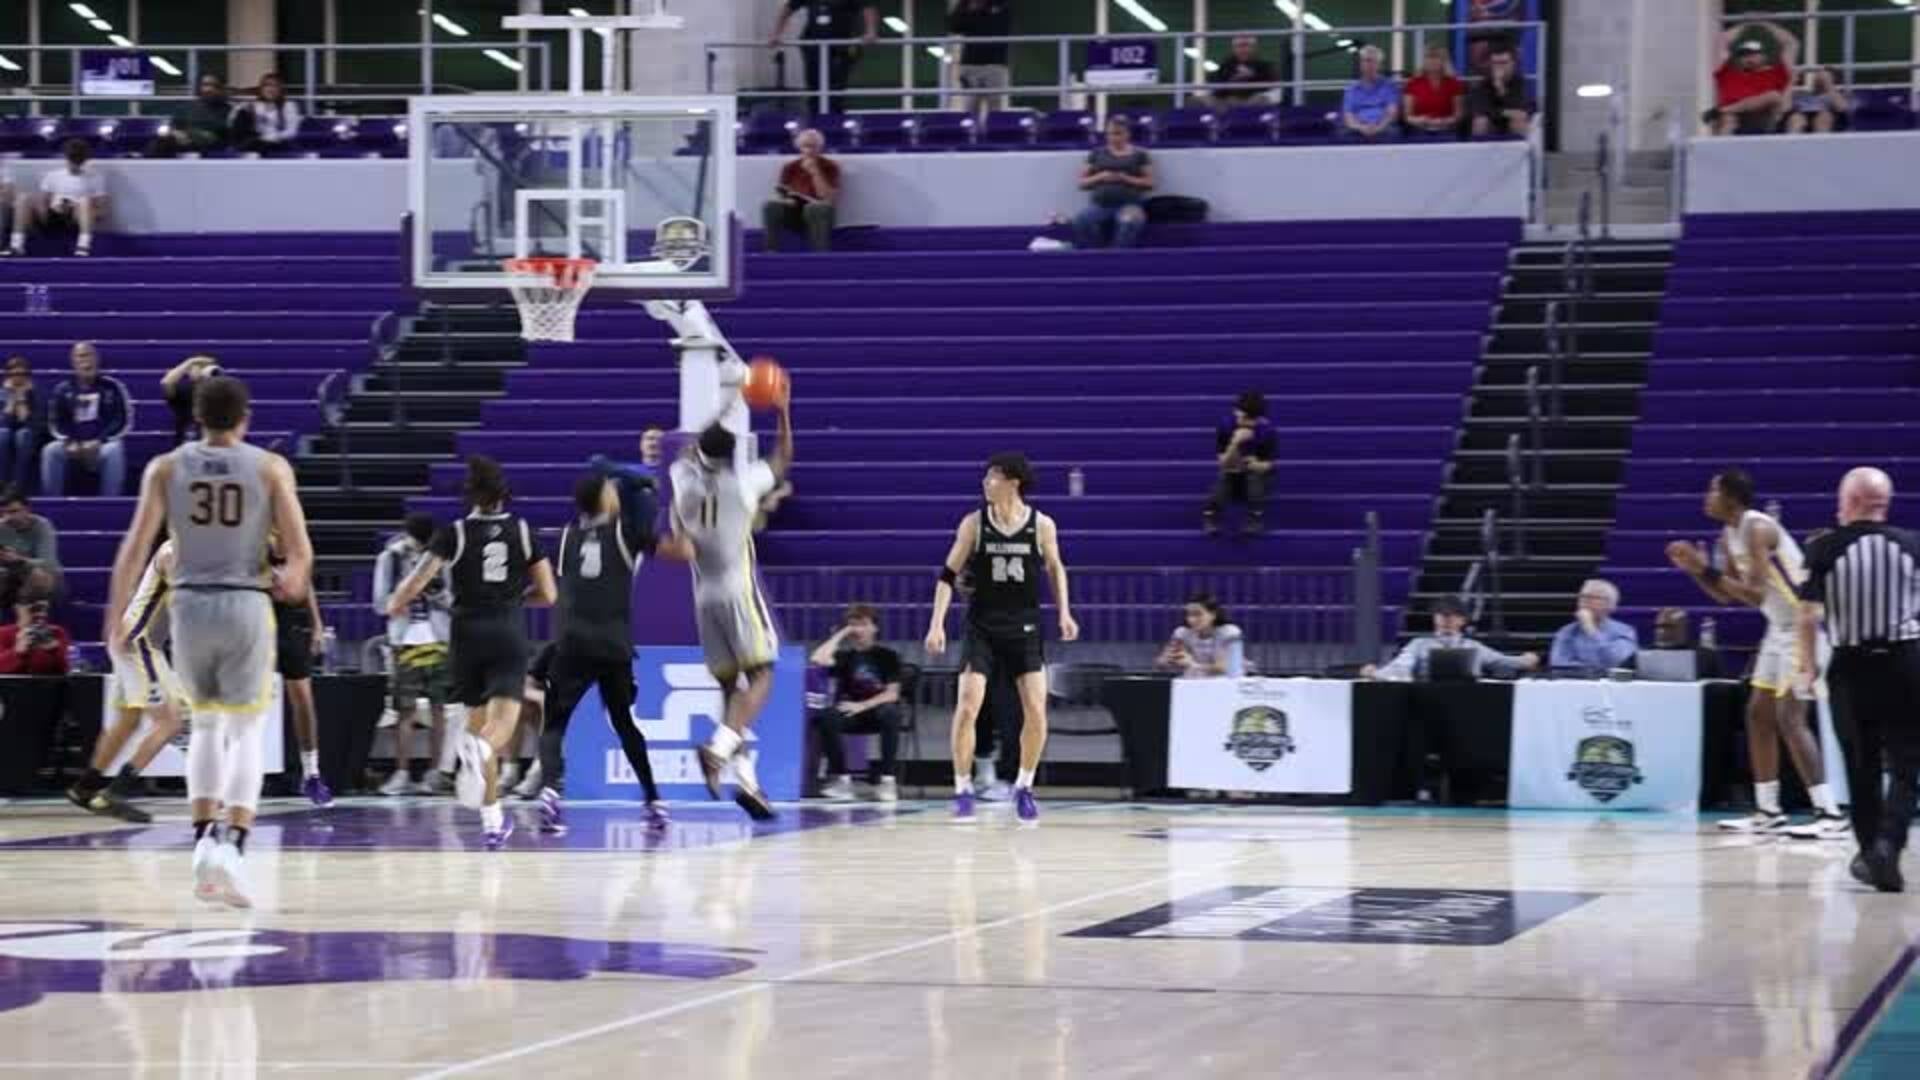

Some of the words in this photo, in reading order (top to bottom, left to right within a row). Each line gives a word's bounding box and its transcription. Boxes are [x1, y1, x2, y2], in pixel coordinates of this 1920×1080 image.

[1111, 46, 1146, 65] 102
[189, 482, 243, 527] 30
[701, 496, 717, 528] 11
[483, 541, 508, 582] 2
[992, 555, 1025, 583] 24
